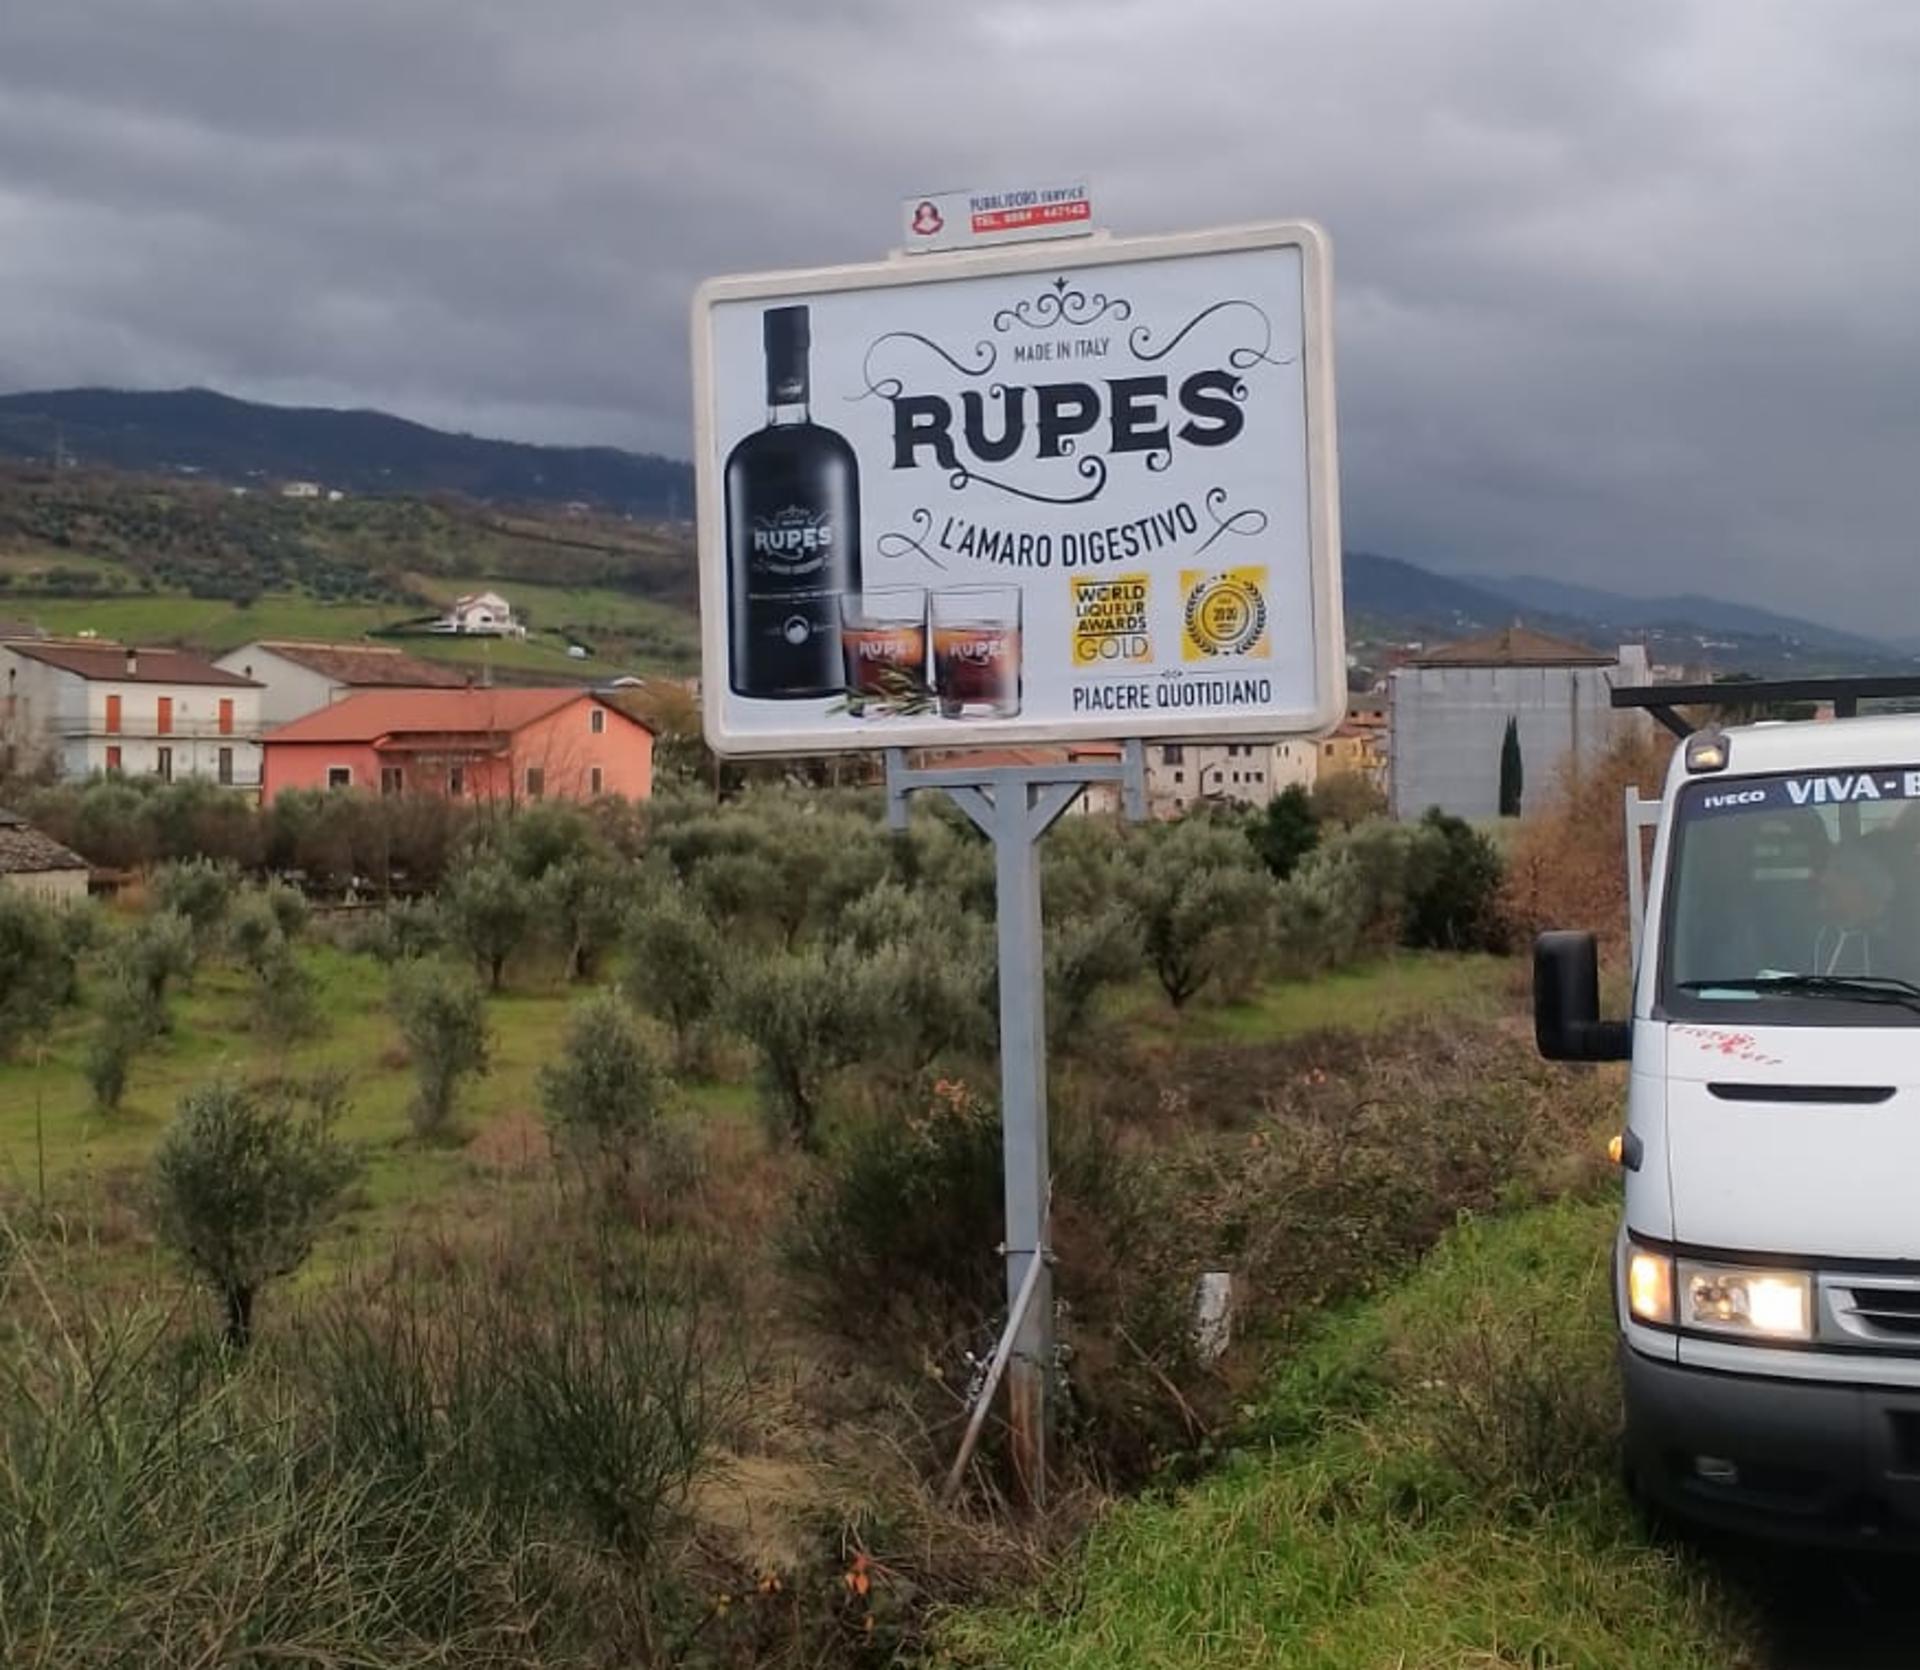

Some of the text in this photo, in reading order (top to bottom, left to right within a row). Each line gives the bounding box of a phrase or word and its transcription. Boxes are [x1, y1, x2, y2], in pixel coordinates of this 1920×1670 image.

[1013, 337, 1110, 362] MADE IN ITALY
[888, 369, 1248, 474] RUPES
[753, 525, 833, 553] RUPES
[939, 502, 1198, 568] L'AMARO DIGESTIVO
[1075, 585, 1146, 602] WORLD
[1076, 602, 1146, 618] LIQUEUR
[1077, 616, 1148, 632] AWARDS
[1076, 636, 1149, 661] GOLD
[1072, 679, 1272, 711] PIACERE QUOTIDIANO
[1704, 789, 1766, 809] IVECO
